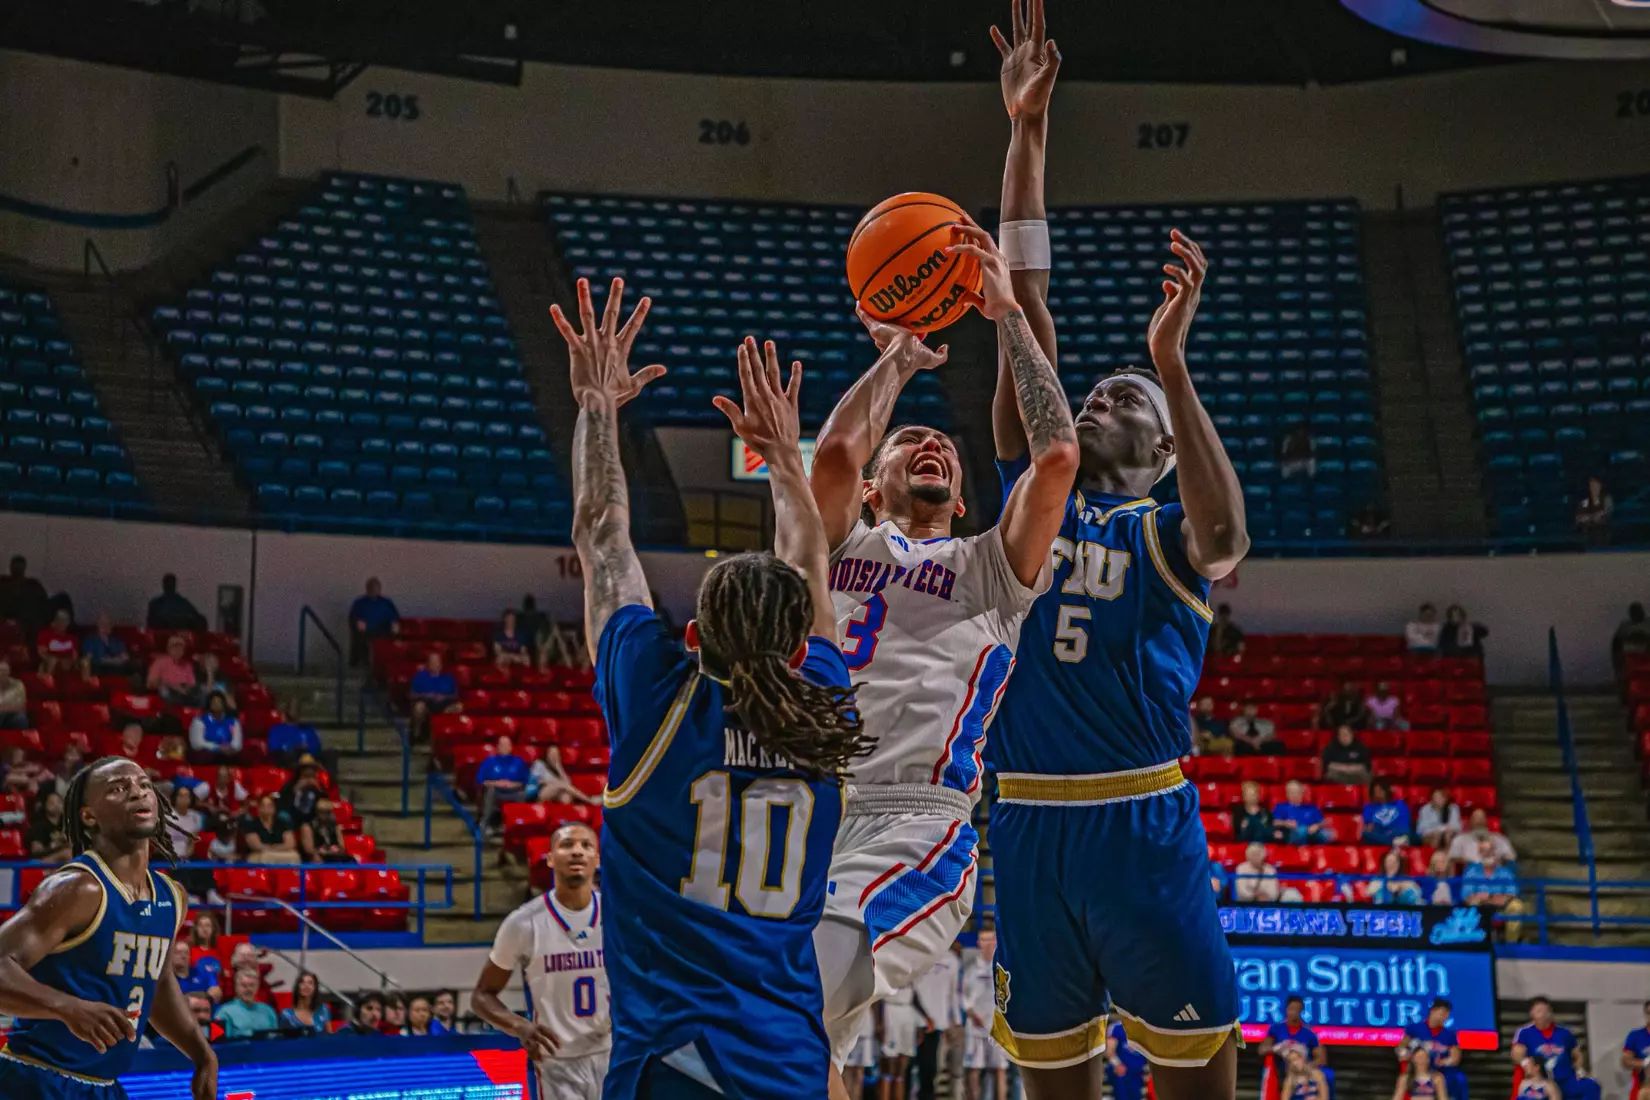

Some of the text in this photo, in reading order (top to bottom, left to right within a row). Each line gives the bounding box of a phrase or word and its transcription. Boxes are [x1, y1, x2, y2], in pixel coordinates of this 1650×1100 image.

[365, 90, 420, 120] 205
[1616, 89, 1650, 118] 20
[697, 119, 751, 145] 206
[1137, 122, 1192, 149] 207
[867, 248, 949, 314] Wilson
[909, 283, 967, 328] NCAA
[553, 555, 583, 579] 10
[1051, 535, 1131, 601] FIU
[840, 591, 889, 671] 3
[1053, 604, 1092, 663] 5
[679, 769, 815, 919] 10
[1217, 906, 1347, 936] OUISIANA
[1346, 908, 1424, 938] TECH
[105, 931, 171, 980] FIU
[1306, 953, 1451, 996] Smith
[127, 985, 145, 1031] 2
[573, 975, 597, 1018] 0
